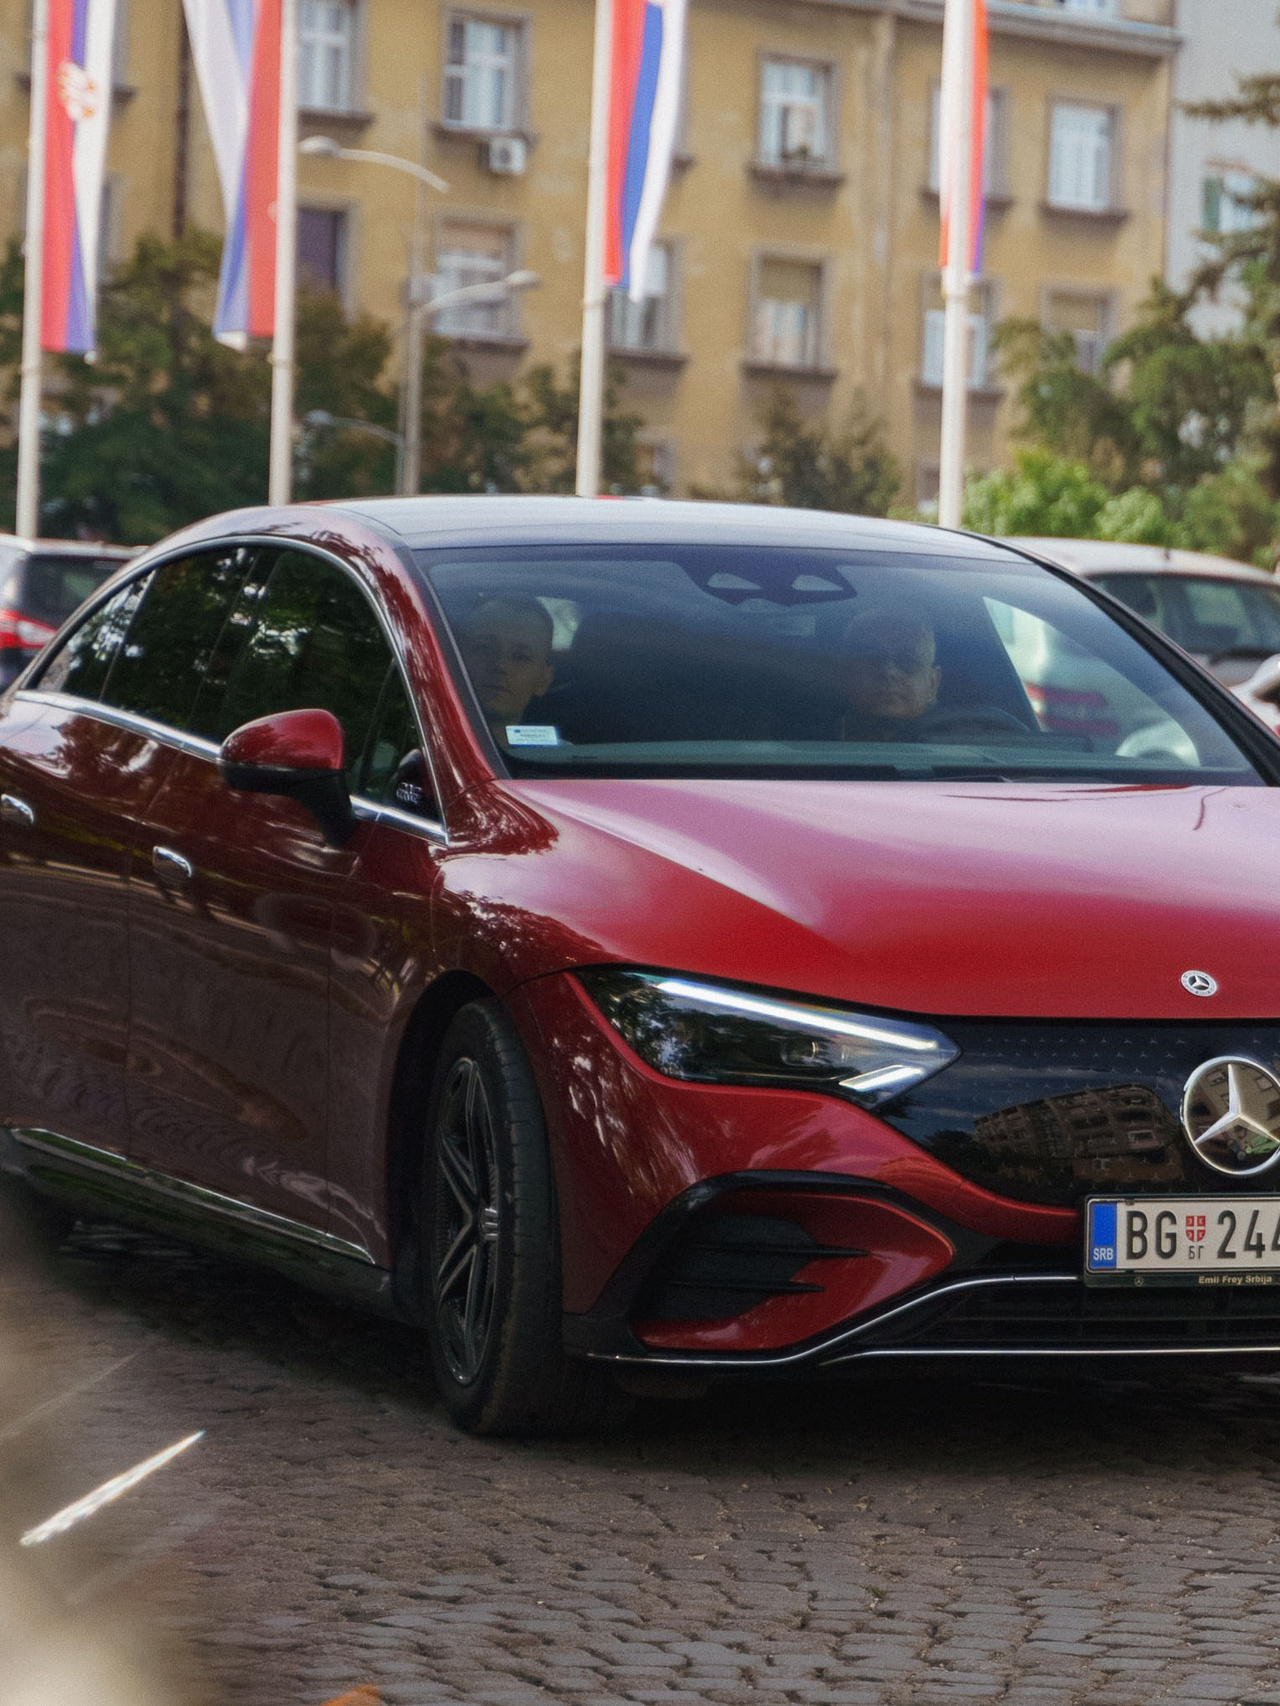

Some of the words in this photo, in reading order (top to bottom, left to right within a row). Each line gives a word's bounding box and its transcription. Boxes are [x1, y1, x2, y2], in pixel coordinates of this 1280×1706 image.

[1126, 1210, 1178, 1260] BG
[1093, 1247, 1114, 1261] SRB
[1198, 1275, 1219, 1284] Emil
[1222, 1274, 1243, 1285] Frey
[1245, 1274, 1273, 1285] Srbija
